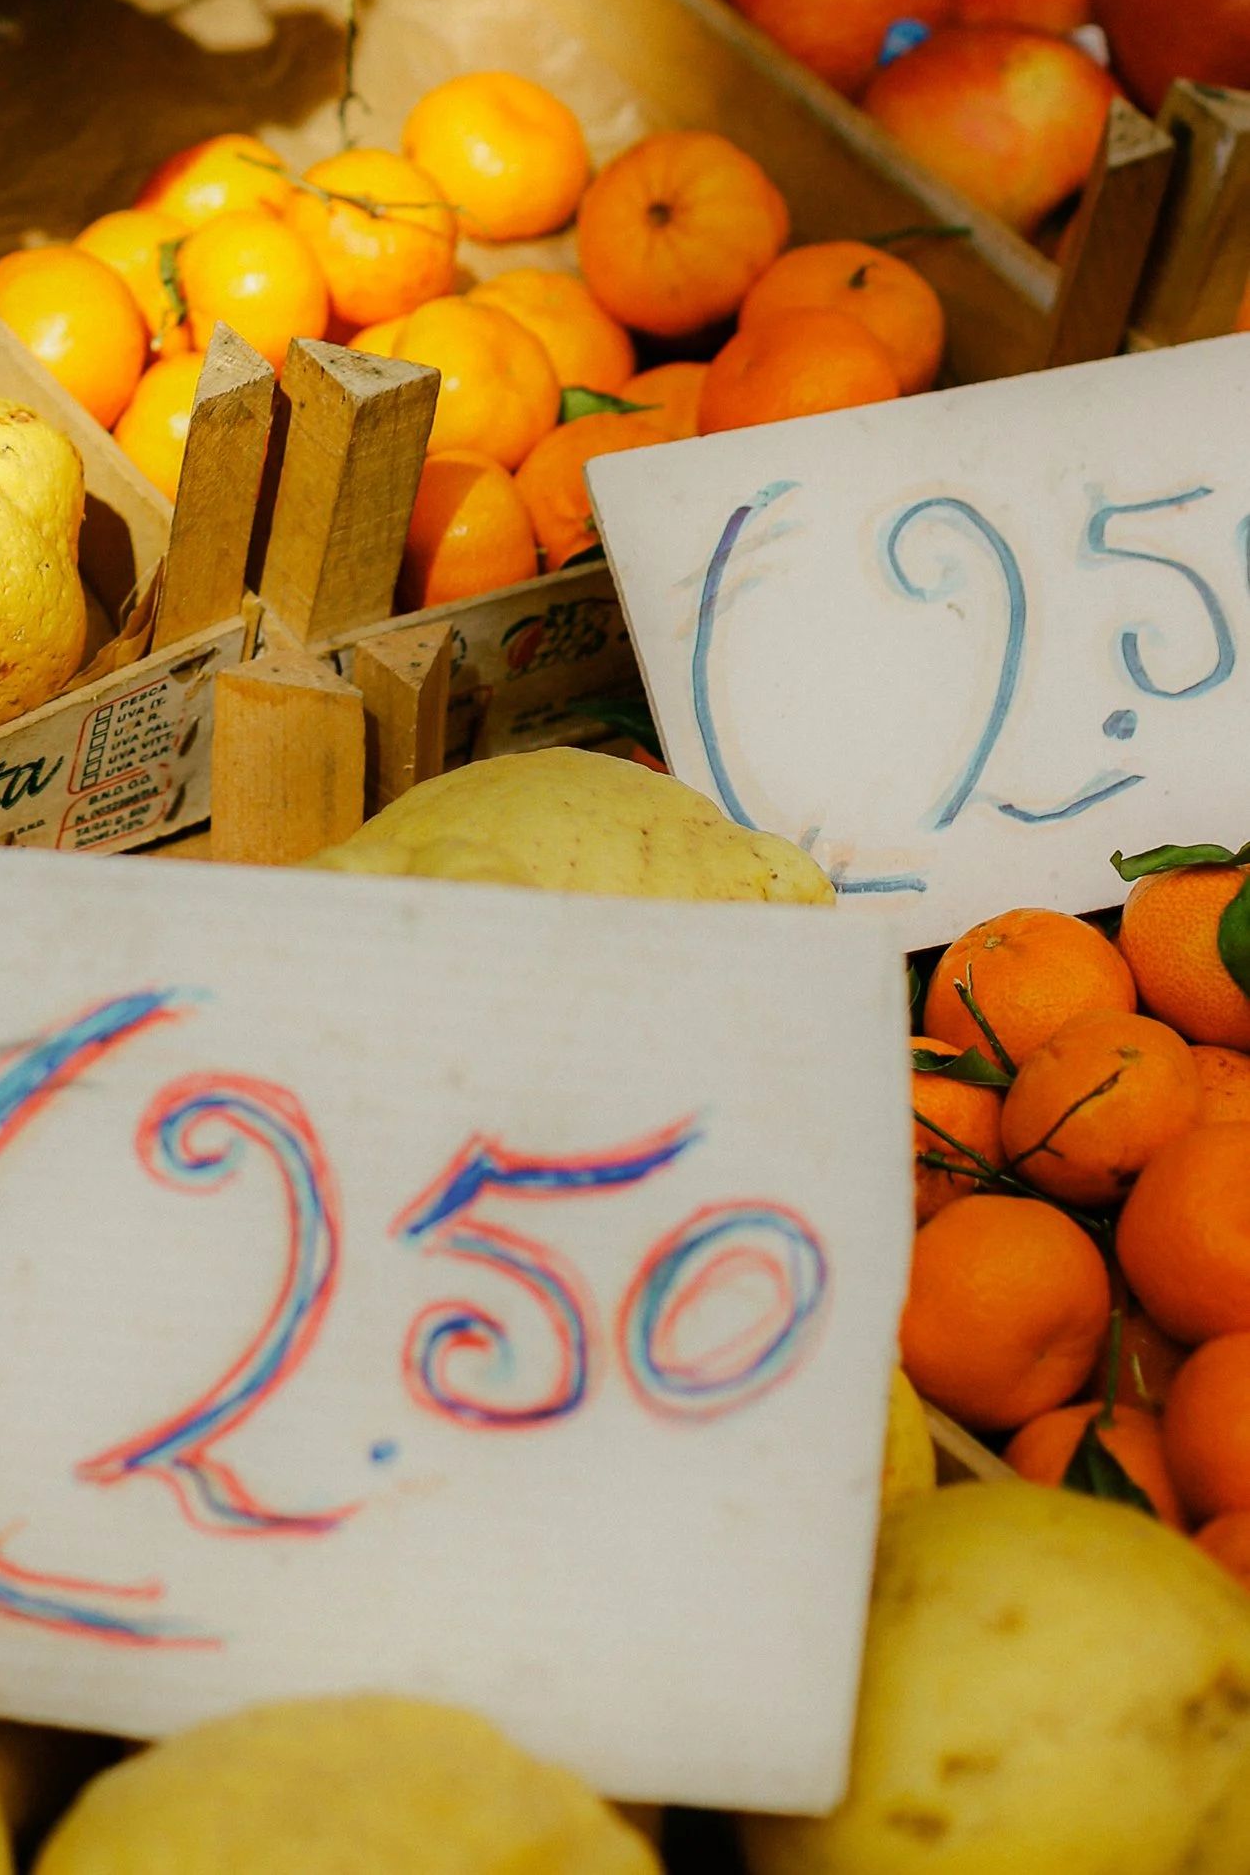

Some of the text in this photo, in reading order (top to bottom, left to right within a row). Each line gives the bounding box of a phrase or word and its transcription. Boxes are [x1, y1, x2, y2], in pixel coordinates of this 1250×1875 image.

[119, 684, 168, 710] PESCA
[117, 706, 146, 723] UVA
[114, 719, 142, 737] UA
[111, 733, 139, 751] UVA
[108, 748, 137, 765] UVA
[105, 761, 134, 777] UVA
